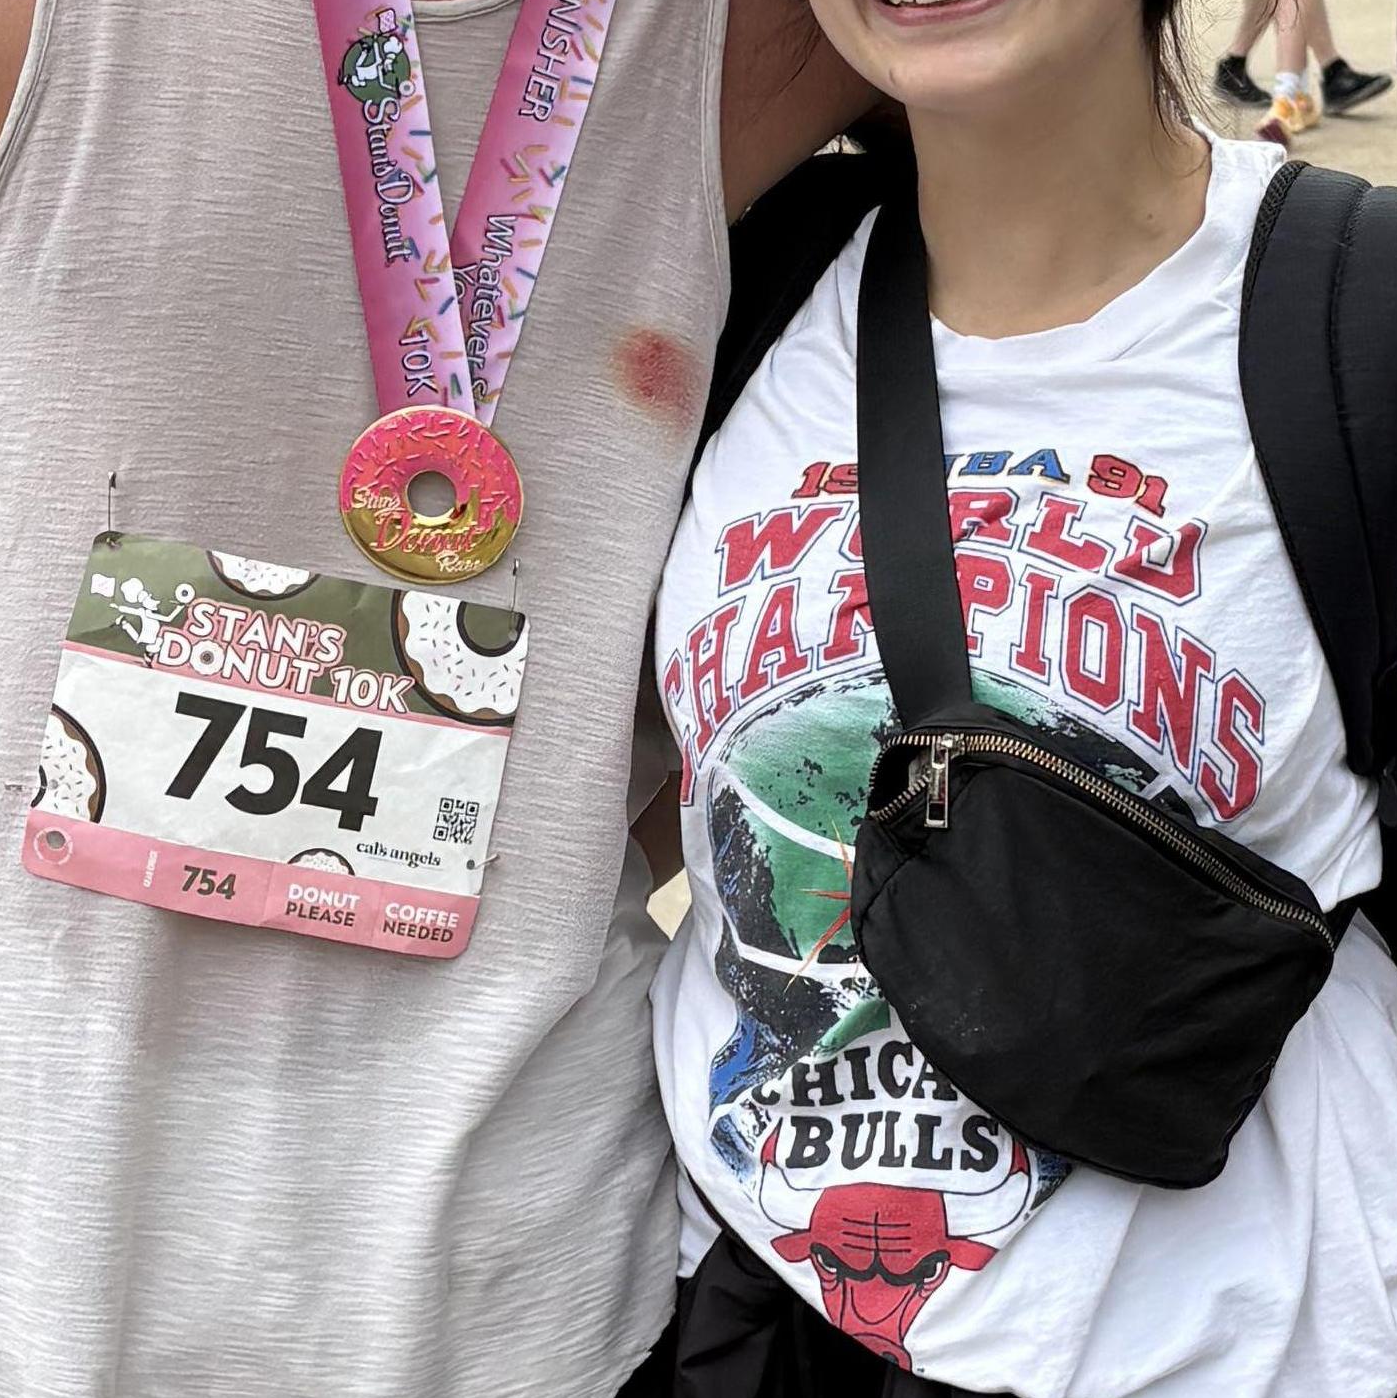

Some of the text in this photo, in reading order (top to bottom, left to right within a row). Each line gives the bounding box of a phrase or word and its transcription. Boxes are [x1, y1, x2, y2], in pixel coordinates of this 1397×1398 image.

[467, 214, 518, 370] Whatever
[399, 329, 439, 399] 10K
[1087, 453, 1170, 517] 91
[716, 486, 1208, 606] WRLD
[188, 601, 343, 664] STAN'S
[158, 628, 414, 713] DONUT 10K
[164, 691, 383, 833] 754
[182, 864, 237, 900] 754
[389, 848, 442, 868] angels
[284, 901, 356, 928] PLEASE
[287, 882, 361, 910] DONUT
[385, 903, 460, 929] COFFEE
[382, 919, 454, 943] NEEDED
[751, 1040, 959, 1107] CHICA
[785, 1111, 1000, 1173] BULLS
